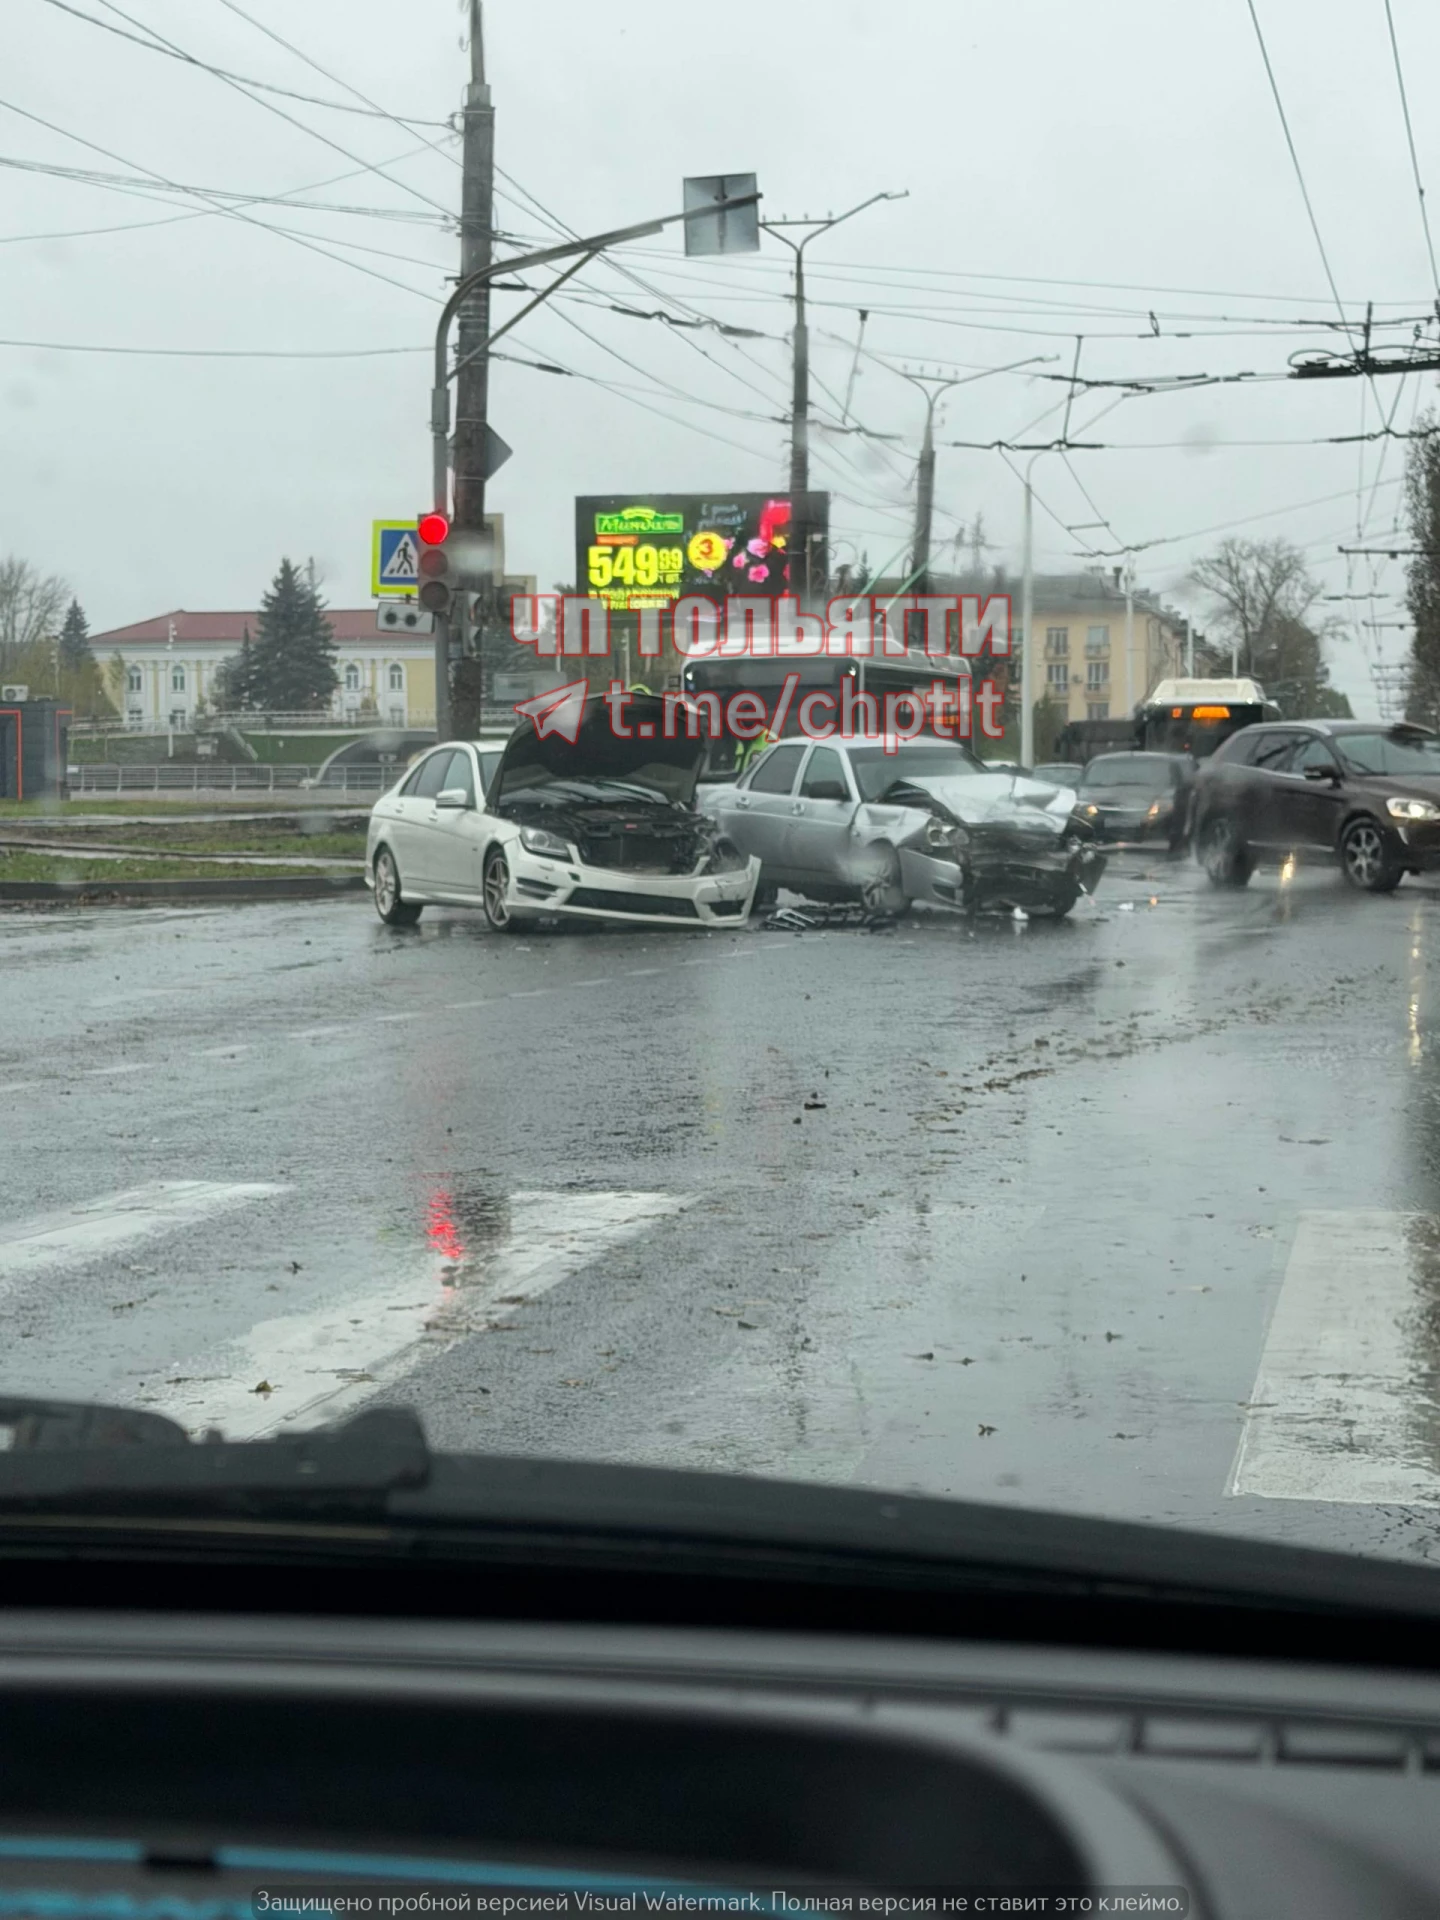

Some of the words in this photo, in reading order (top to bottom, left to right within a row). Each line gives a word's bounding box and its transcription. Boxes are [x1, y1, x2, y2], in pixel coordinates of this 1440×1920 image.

[699, 539, 714, 556] 3
[588, 545, 658, 587] 549
[659, 548, 683, 570] 99
